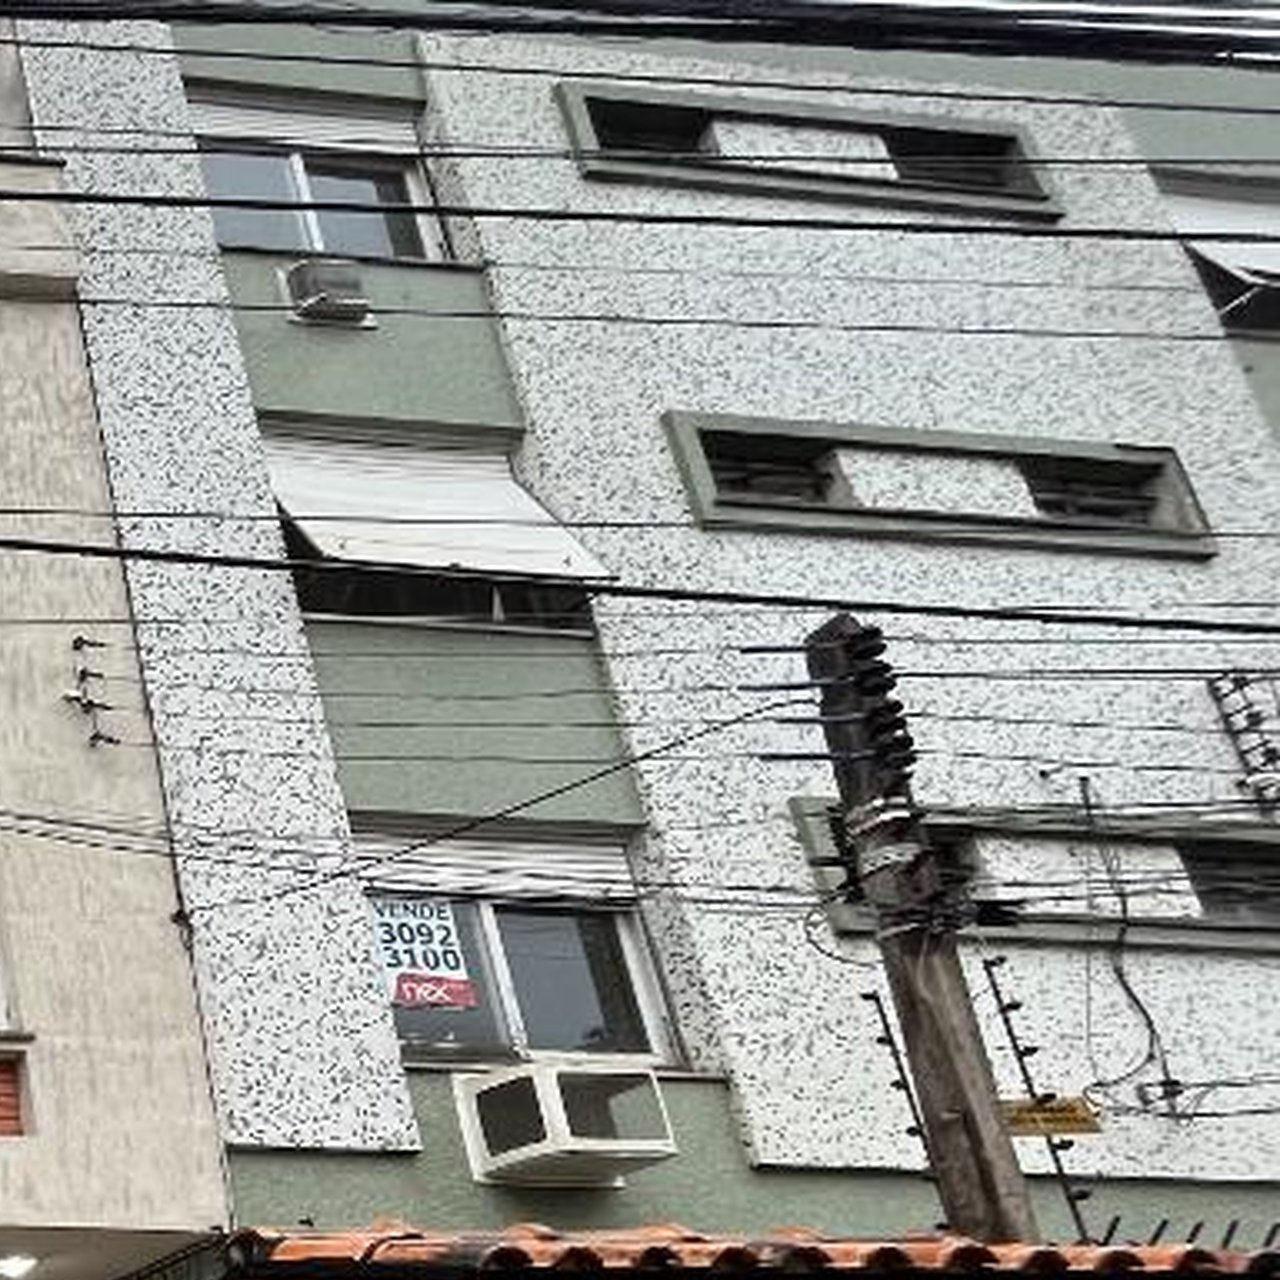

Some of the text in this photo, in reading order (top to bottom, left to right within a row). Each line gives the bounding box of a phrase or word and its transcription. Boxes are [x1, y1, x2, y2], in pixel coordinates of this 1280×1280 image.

[373, 902, 450, 920] VENDE
[378, 922, 455, 946] 3092
[383, 946, 461, 970] 3100
